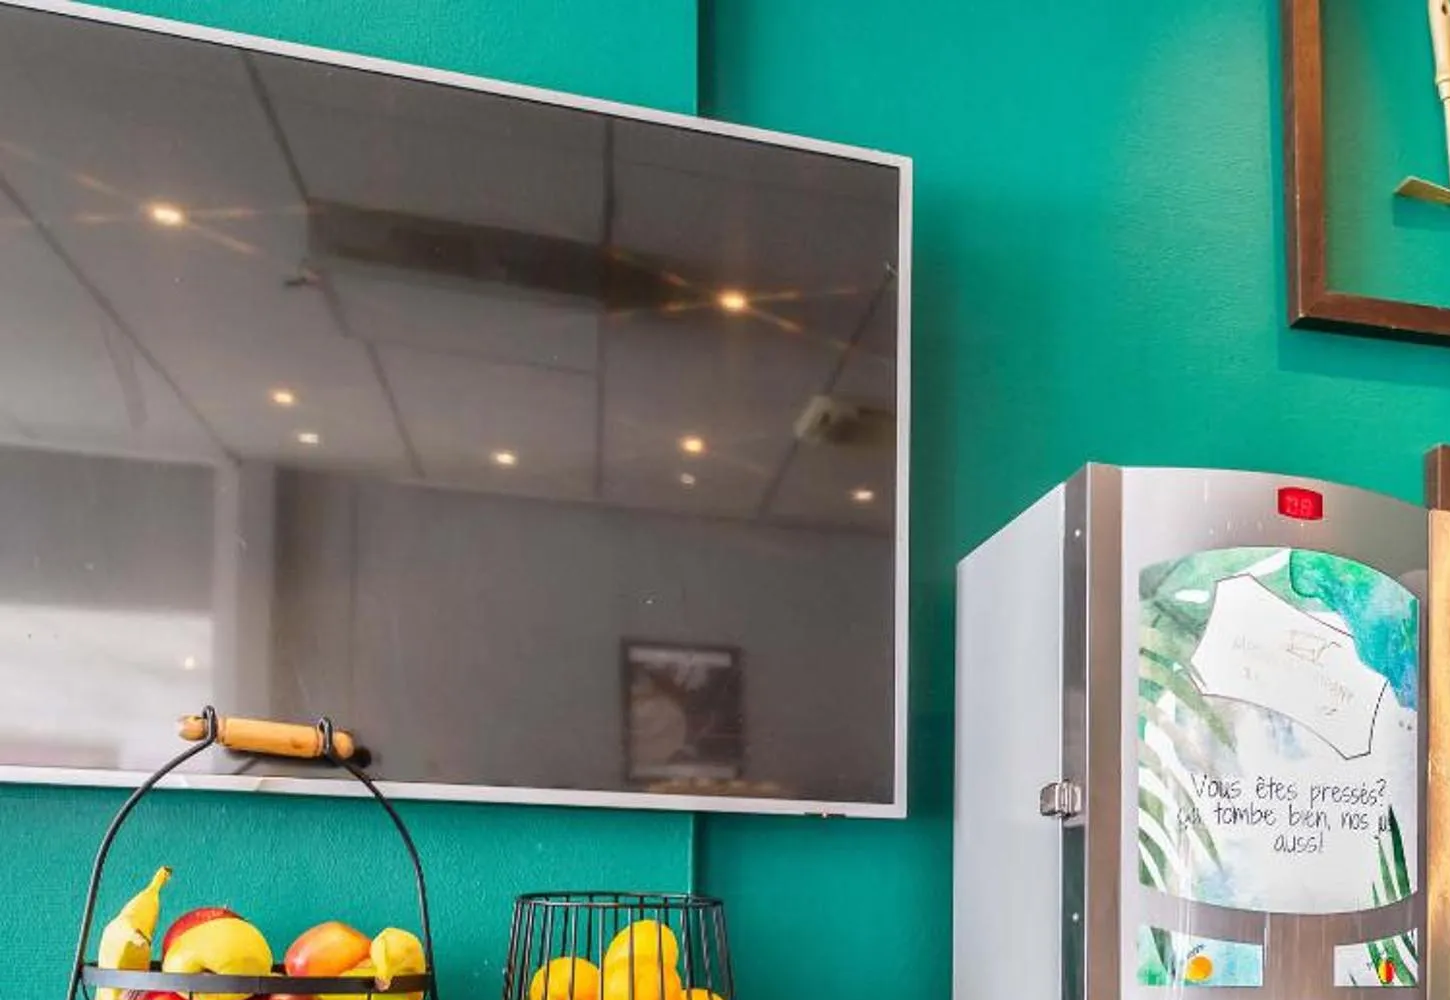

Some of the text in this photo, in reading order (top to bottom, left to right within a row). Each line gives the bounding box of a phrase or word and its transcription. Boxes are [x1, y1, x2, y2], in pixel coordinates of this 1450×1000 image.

[1191, 773, 1387, 808] Vous êtes pressés?
[1213, 801, 1277, 826] tombe
[1341, 811, 1370, 831] nos
